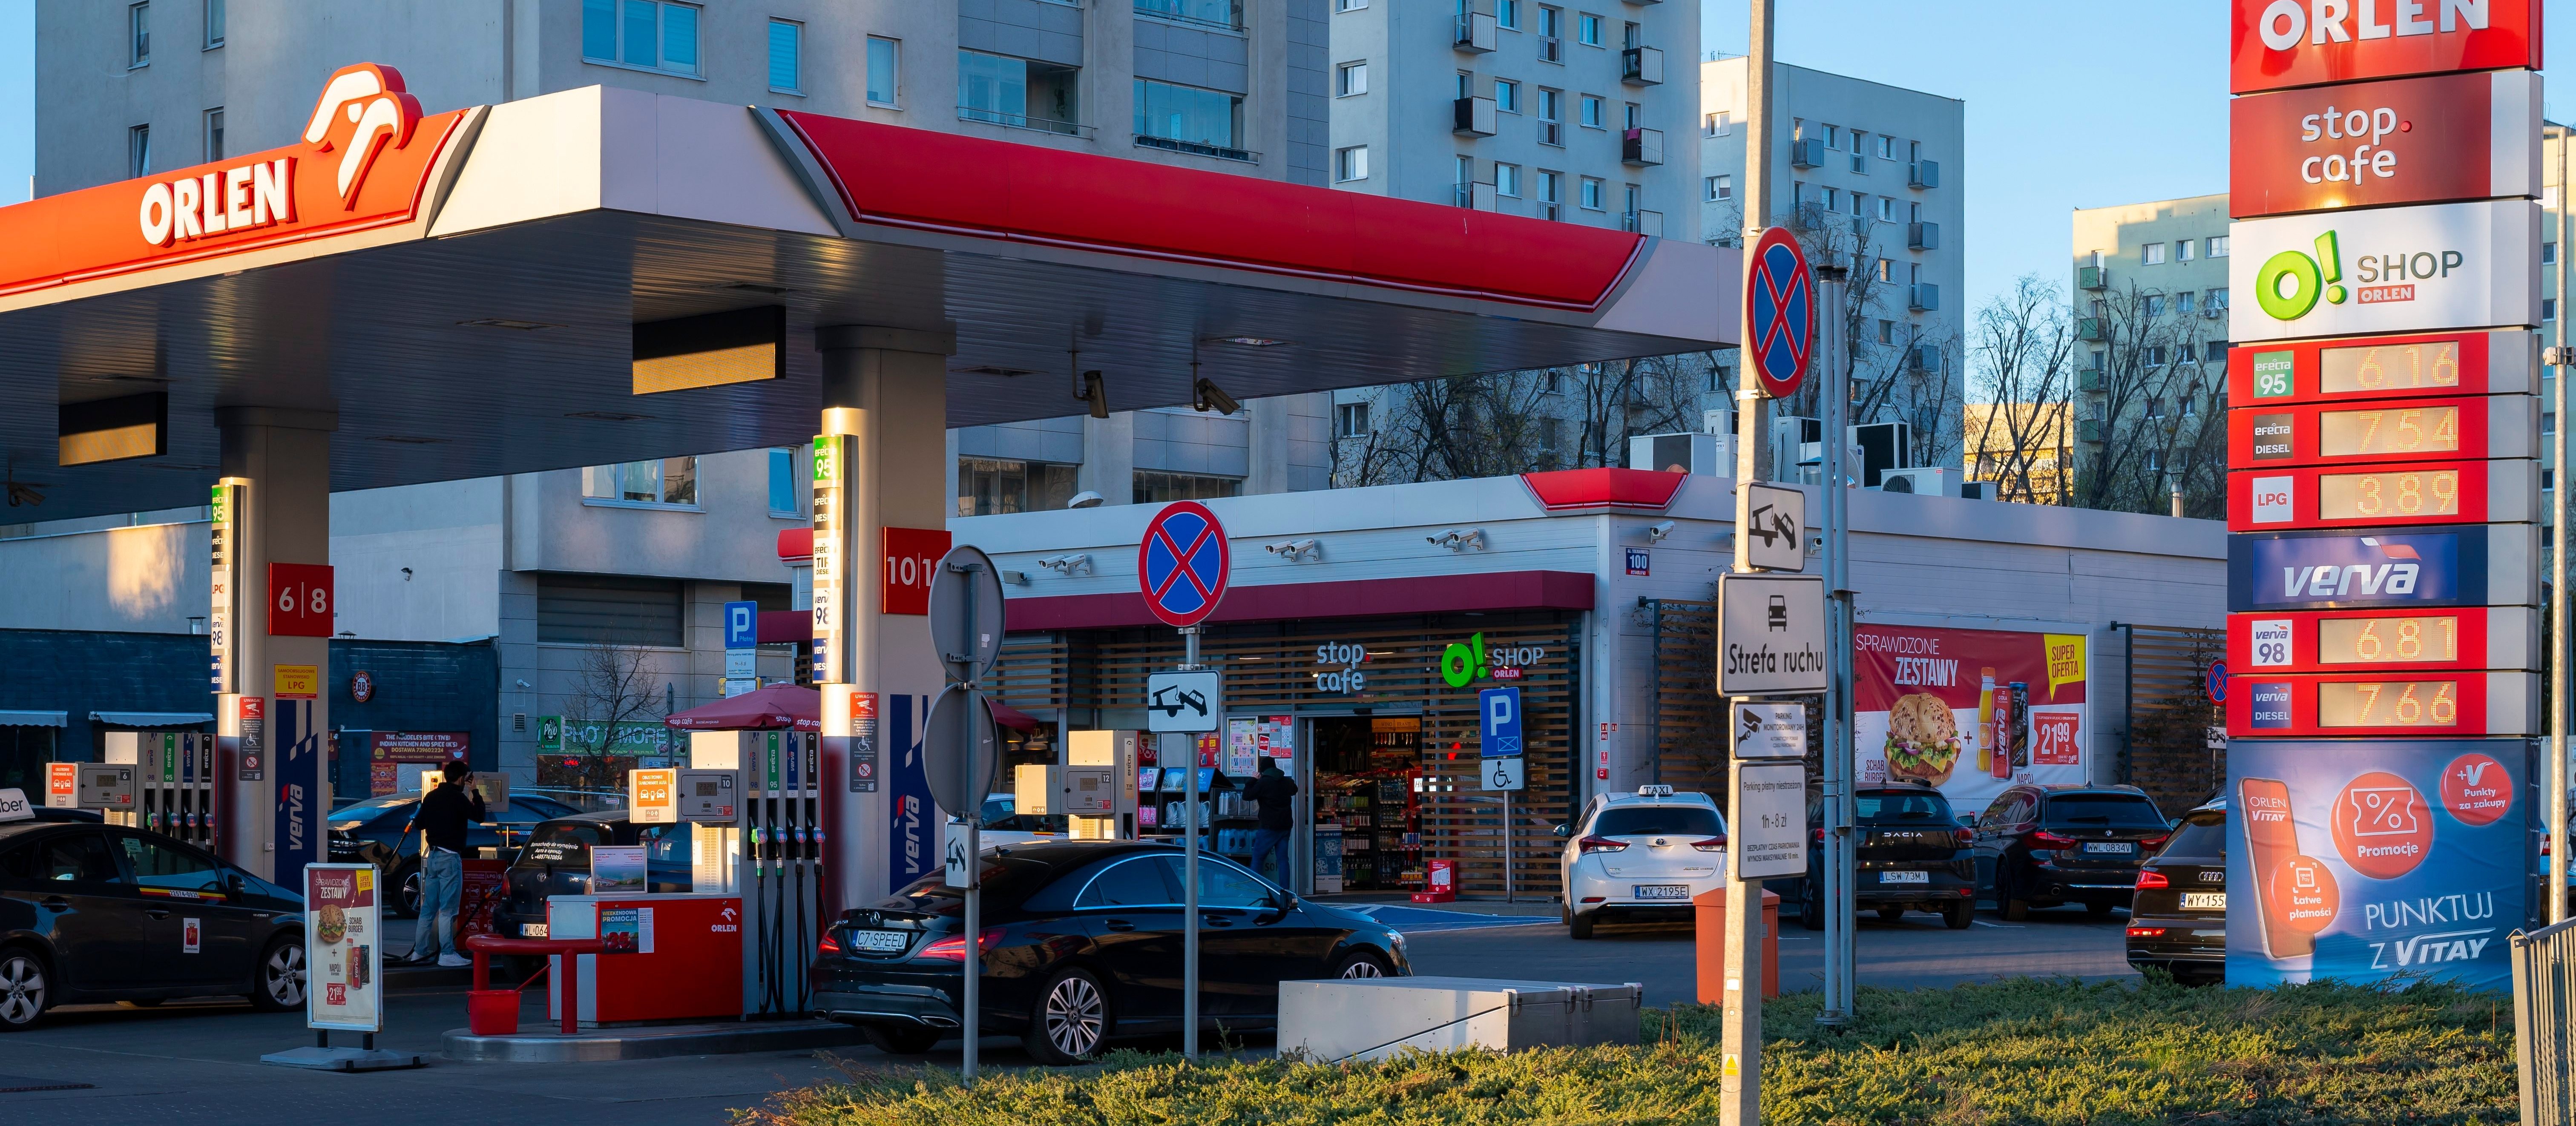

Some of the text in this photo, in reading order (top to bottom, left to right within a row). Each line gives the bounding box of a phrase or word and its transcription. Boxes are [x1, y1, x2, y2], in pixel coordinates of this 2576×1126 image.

[2259, 0, 2490, 51] ORLEN
[2301, 145, 2397, 186] cafe
[140, 158, 289, 245] ORLEN
[2357, 250, 2463, 283] SHOP
[2360, 287, 2412, 303] ORLEN
[2255, 359, 2291, 371] efecta
[2358, 344, 2458, 388] 6.16
[2260, 373, 2286, 395] 95
[2255, 422, 2290, 435] efecta
[2359, 409, 2458, 453] 7.54
[2256, 444, 2290, 454] DIESEL
[816, 459, 832, 477] 95
[2258, 492, 2287, 507] LPG
[2358, 473, 2457, 515] 3.89
[213, 506, 224, 521] 95
[1630, 554, 1647, 569] 100
[2283, 563, 2420, 597] verva
[732, 607, 750, 642] P
[213, 630, 223, 646] 98
[2256, 629, 2288, 640] verva
[2356, 619, 2453, 660] 6.81
[1856, 634, 1940, 655] SPRAWDZONE
[1493, 647, 1544, 666] SHOP
[1728, 642, 1823, 675] Strefa ruchu
[2052, 644, 2075, 661] SUPER
[2259, 643, 2285, 664] 98
[1494, 669, 1519, 678] ORLEN
[1895, 657, 1958, 687] ZESTAWY
[2052, 660, 2079, 678] OFERTA
[288, 681, 305, 689] LPG
[1317, 668, 1364, 694] cafe
[2256, 692, 2288, 702] verva
[2358, 683, 2456, 724] 7.66
[776, 715, 791, 723] stop
[1490, 695, 1512, 736] P
[2255, 712, 2290, 721] DIESEL
[618, 727, 666, 744] MORE
[1866, 759, 1885, 771] SCHAB
[2016, 772, 2034, 784] NAPÓJ
[1644, 786, 1669, 794] TAXI
[1743, 781, 1803, 793] Parking płatny niestrzeżony
[2464, 787, 2496, 798] Punkty
[0, 798, 23, 813] ber
[2250, 796, 2286, 808] ORLEN
[2474, 799, 2506, 809] zakupy
[290, 784, 303, 850] verva
[1762, 813, 1787, 828] 1h 8 zł
[906, 795, 919, 874] verva
[1747, 844, 1768, 852] BEZPŁATNY
[1778, 842, 1800, 850] PARKOWANIA
[2087, 843, 2130, 852] WWL 0834V
[2358, 842, 2419, 858] Promocje
[1762, 853, 1787, 862] MAKSYMALNIE
[315, 878, 349, 886] SPRAWDZONE
[1885, 872, 1926, 881] LSW 73MJ
[321, 887, 347, 899] ZESTAWY
[1642, 887, 1686, 896] WX 2195E
[2188, 895, 2201, 906] WY
[2294, 896, 2322, 905] Łatwe
[2289, 907, 2332, 921] płatności
[2365, 891, 2493, 930] PUNKTUJ
[348, 925, 363, 933] BURGER
[524, 925, 533, 935] WL
[711, 924, 737, 932] ORLEN
[858, 932, 906, 947] C7 SPEED
[329, 962, 341, 972] NAPÓJ
